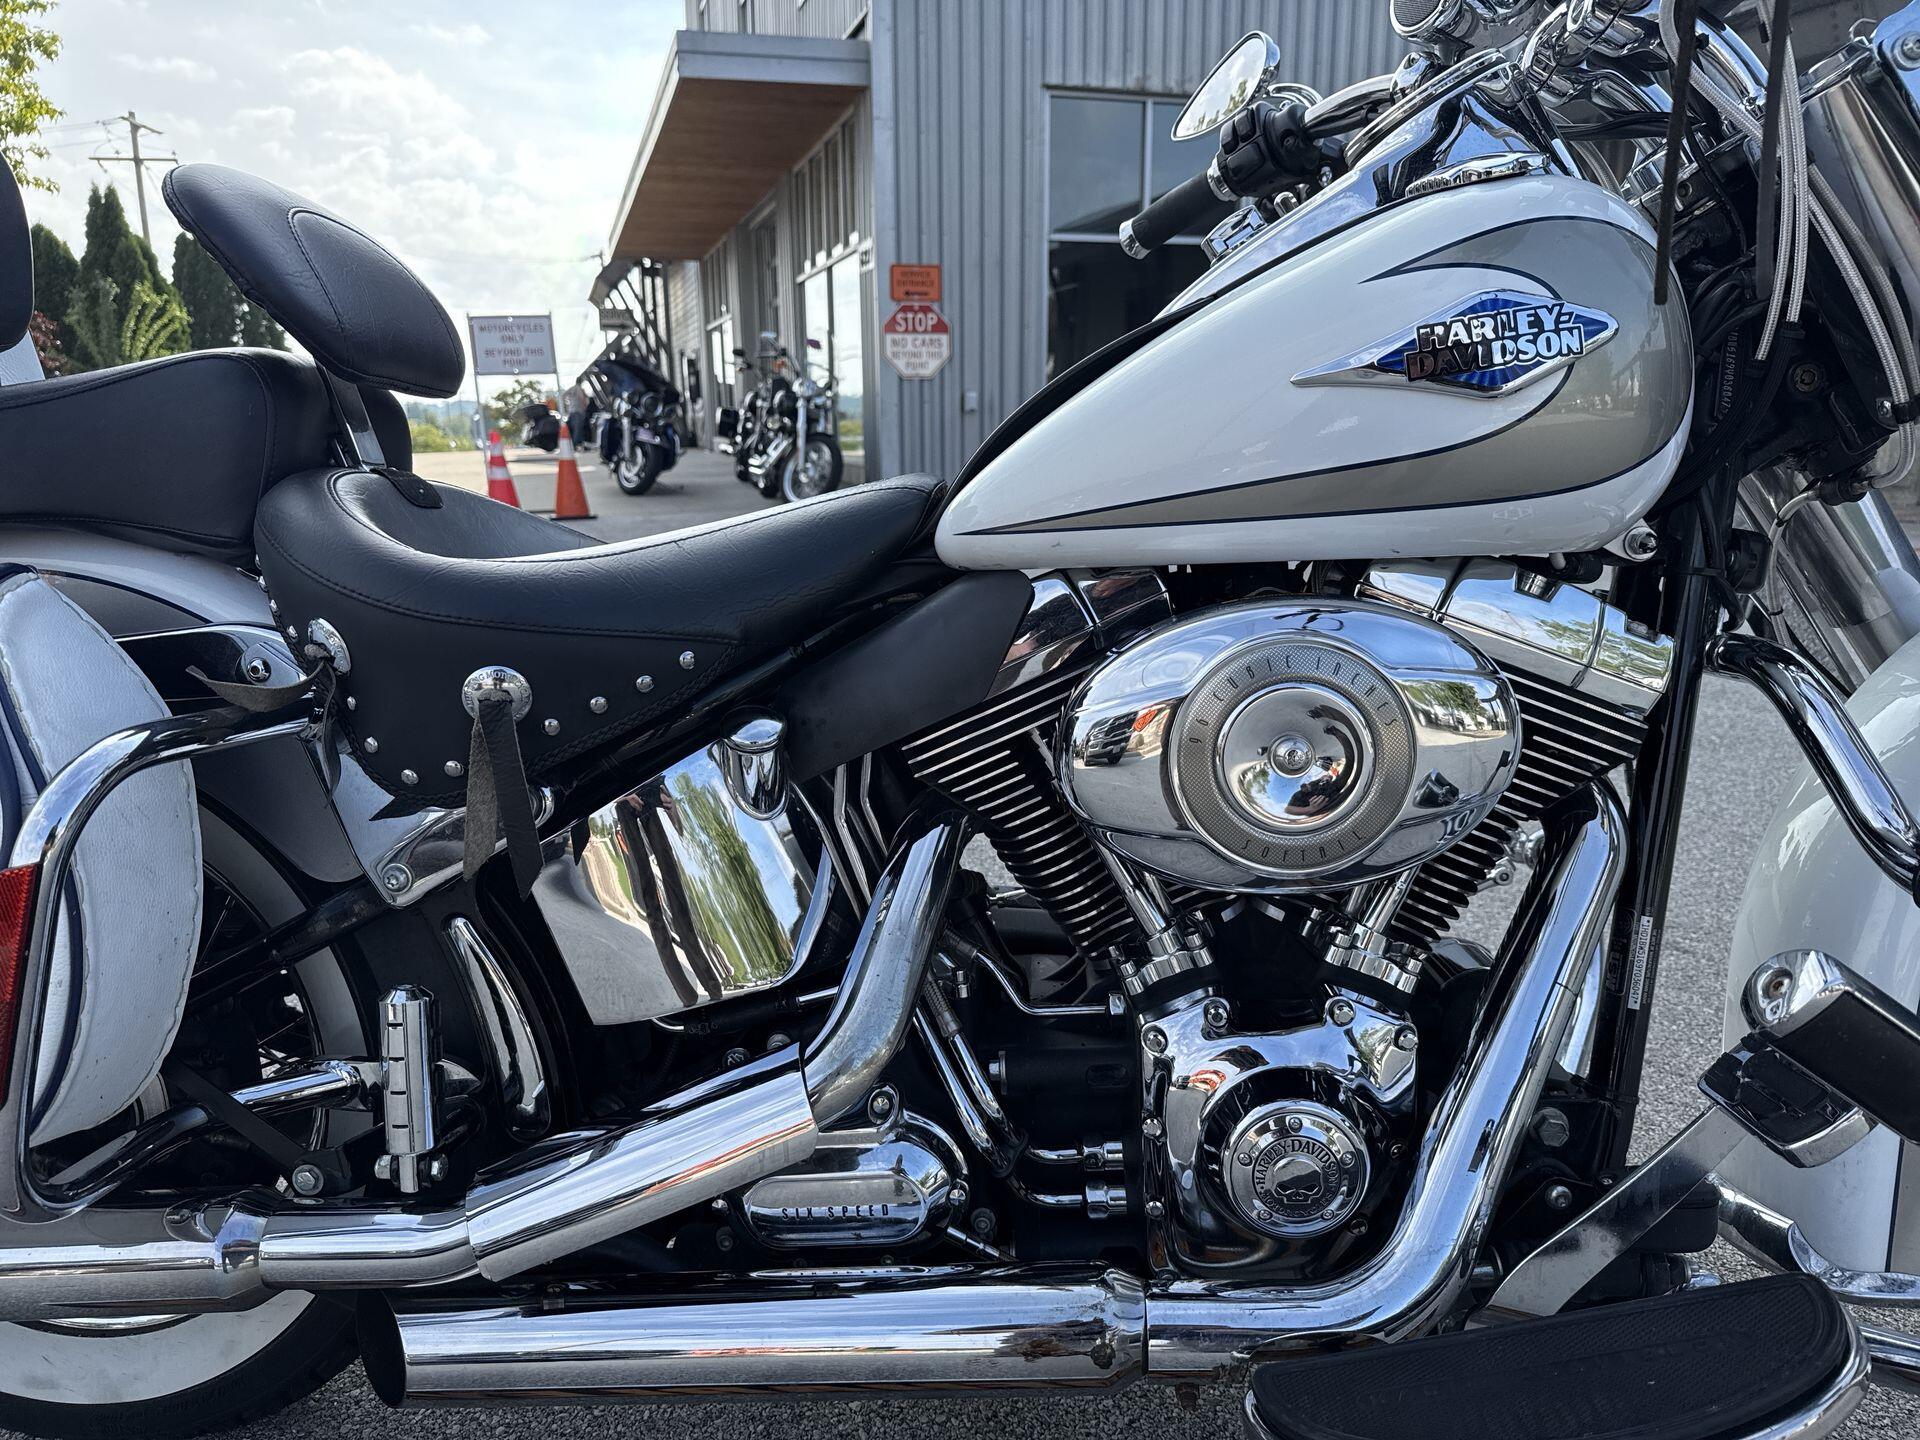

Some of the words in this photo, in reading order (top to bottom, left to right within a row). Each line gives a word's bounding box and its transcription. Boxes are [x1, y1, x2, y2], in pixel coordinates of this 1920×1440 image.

[479, 323, 545, 333] MOTORCYCLES
[895, 312, 938, 332] STOP
[1416, 303, 1576, 352] HARLEY-
[501, 334, 525, 343] ONLY
[891, 337, 908, 349] NO
[911, 337, 944, 349] CARS
[484, 347, 522, 357] BEYOND
[524, 347, 545, 356] THIS
[891, 351, 923, 359] BEYOND
[925, 350, 943, 359] THIS
[1405, 324, 1585, 382] DAVIDSON
[503, 358, 529, 367] POINT
[905, 361, 930, 370] POINT
[1189, 718, 1208, 744] 96
[1213, 655, 1292, 702] CUBIC
[1316, 656, 1398, 727] INCHES
[1241, 830, 1366, 863] SOFTAIL
[781, 1206, 814, 1221] SIX
[827, 1203, 890, 1219] SPEED
